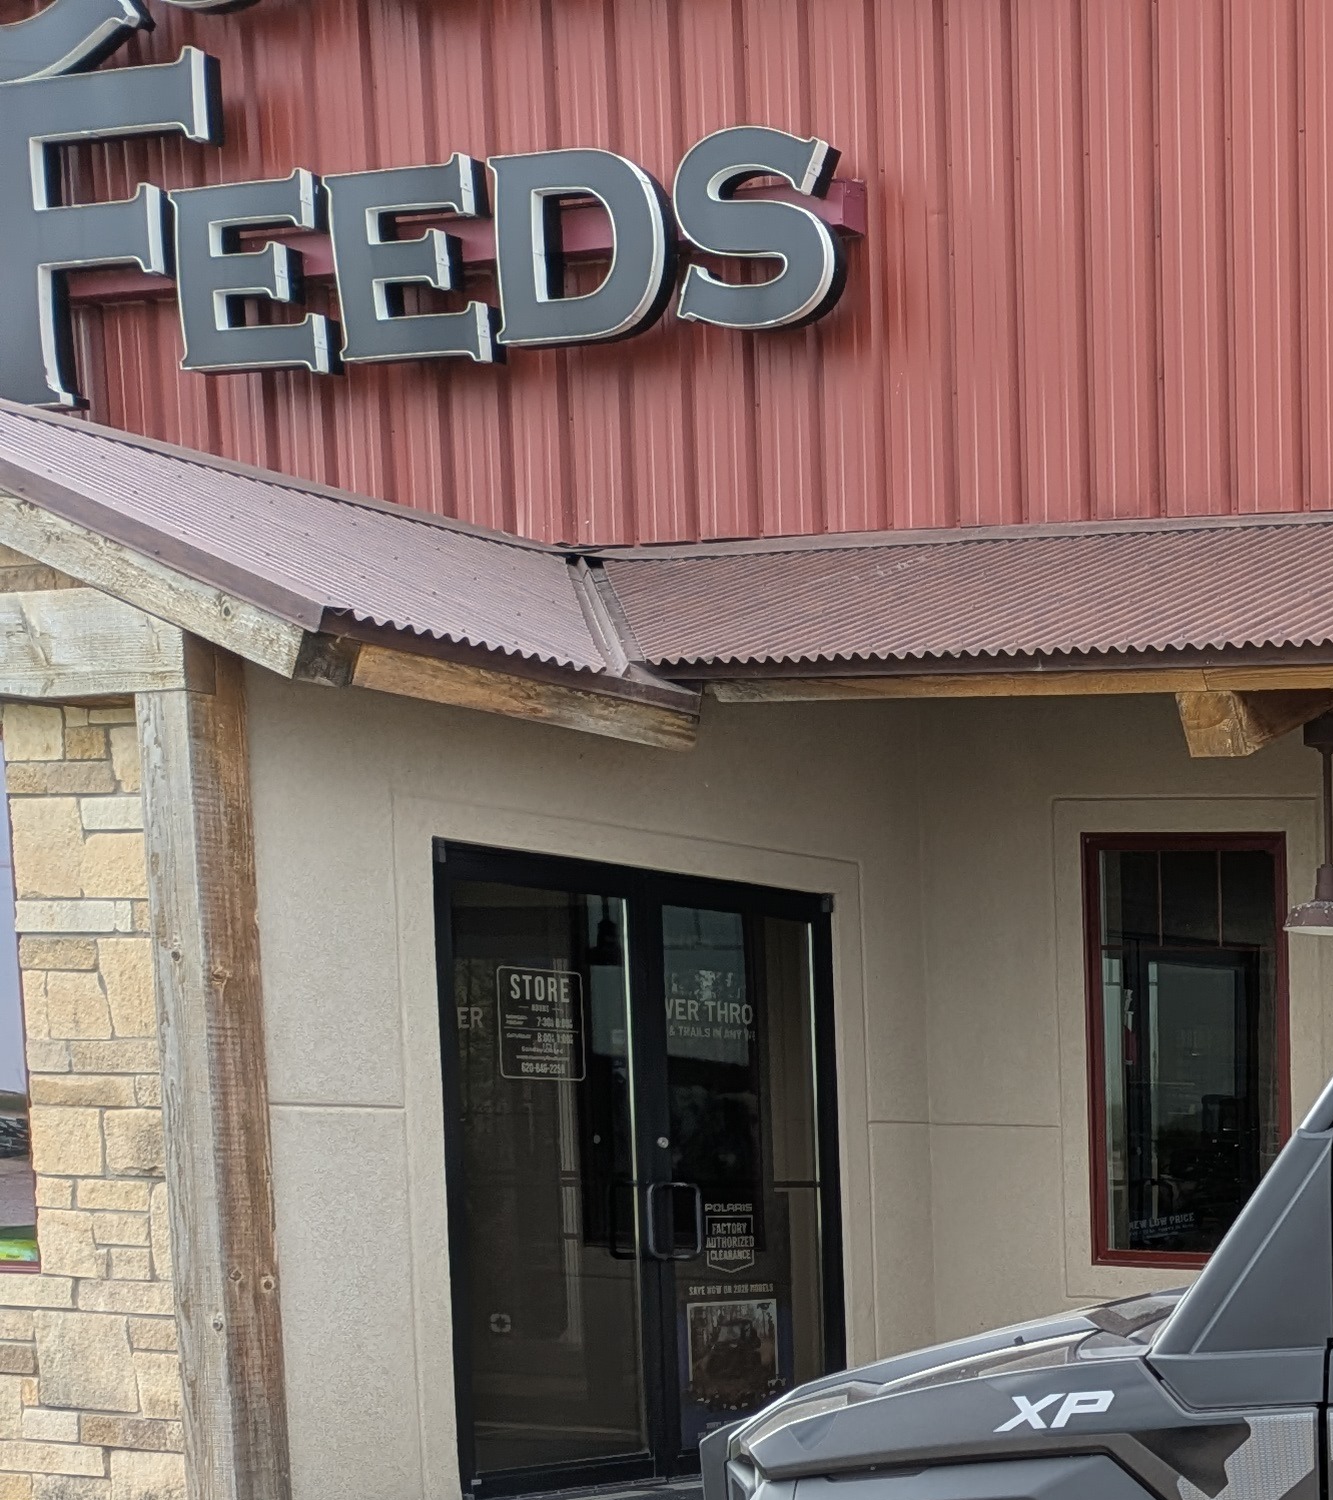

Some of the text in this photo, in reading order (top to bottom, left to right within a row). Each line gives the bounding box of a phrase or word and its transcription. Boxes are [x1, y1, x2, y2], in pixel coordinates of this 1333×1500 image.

[0, 45, 848, 408] FEEDS
[510, 973, 570, 1003] STORE
[679, 1026, 710, 1037] TRAILS
[705, 1203, 752, 1212] POLARIS
[1169, 1212, 1194, 1224] PRICE
[712, 1222, 747, 1235] FACTORY
[706, 1236, 754, 1248] AUTHORIZED
[710, 1249, 751, 1260] CLEARANCE
[689, 1286, 706, 1295] SAVE
[993, 1390, 1115, 1432] XP
